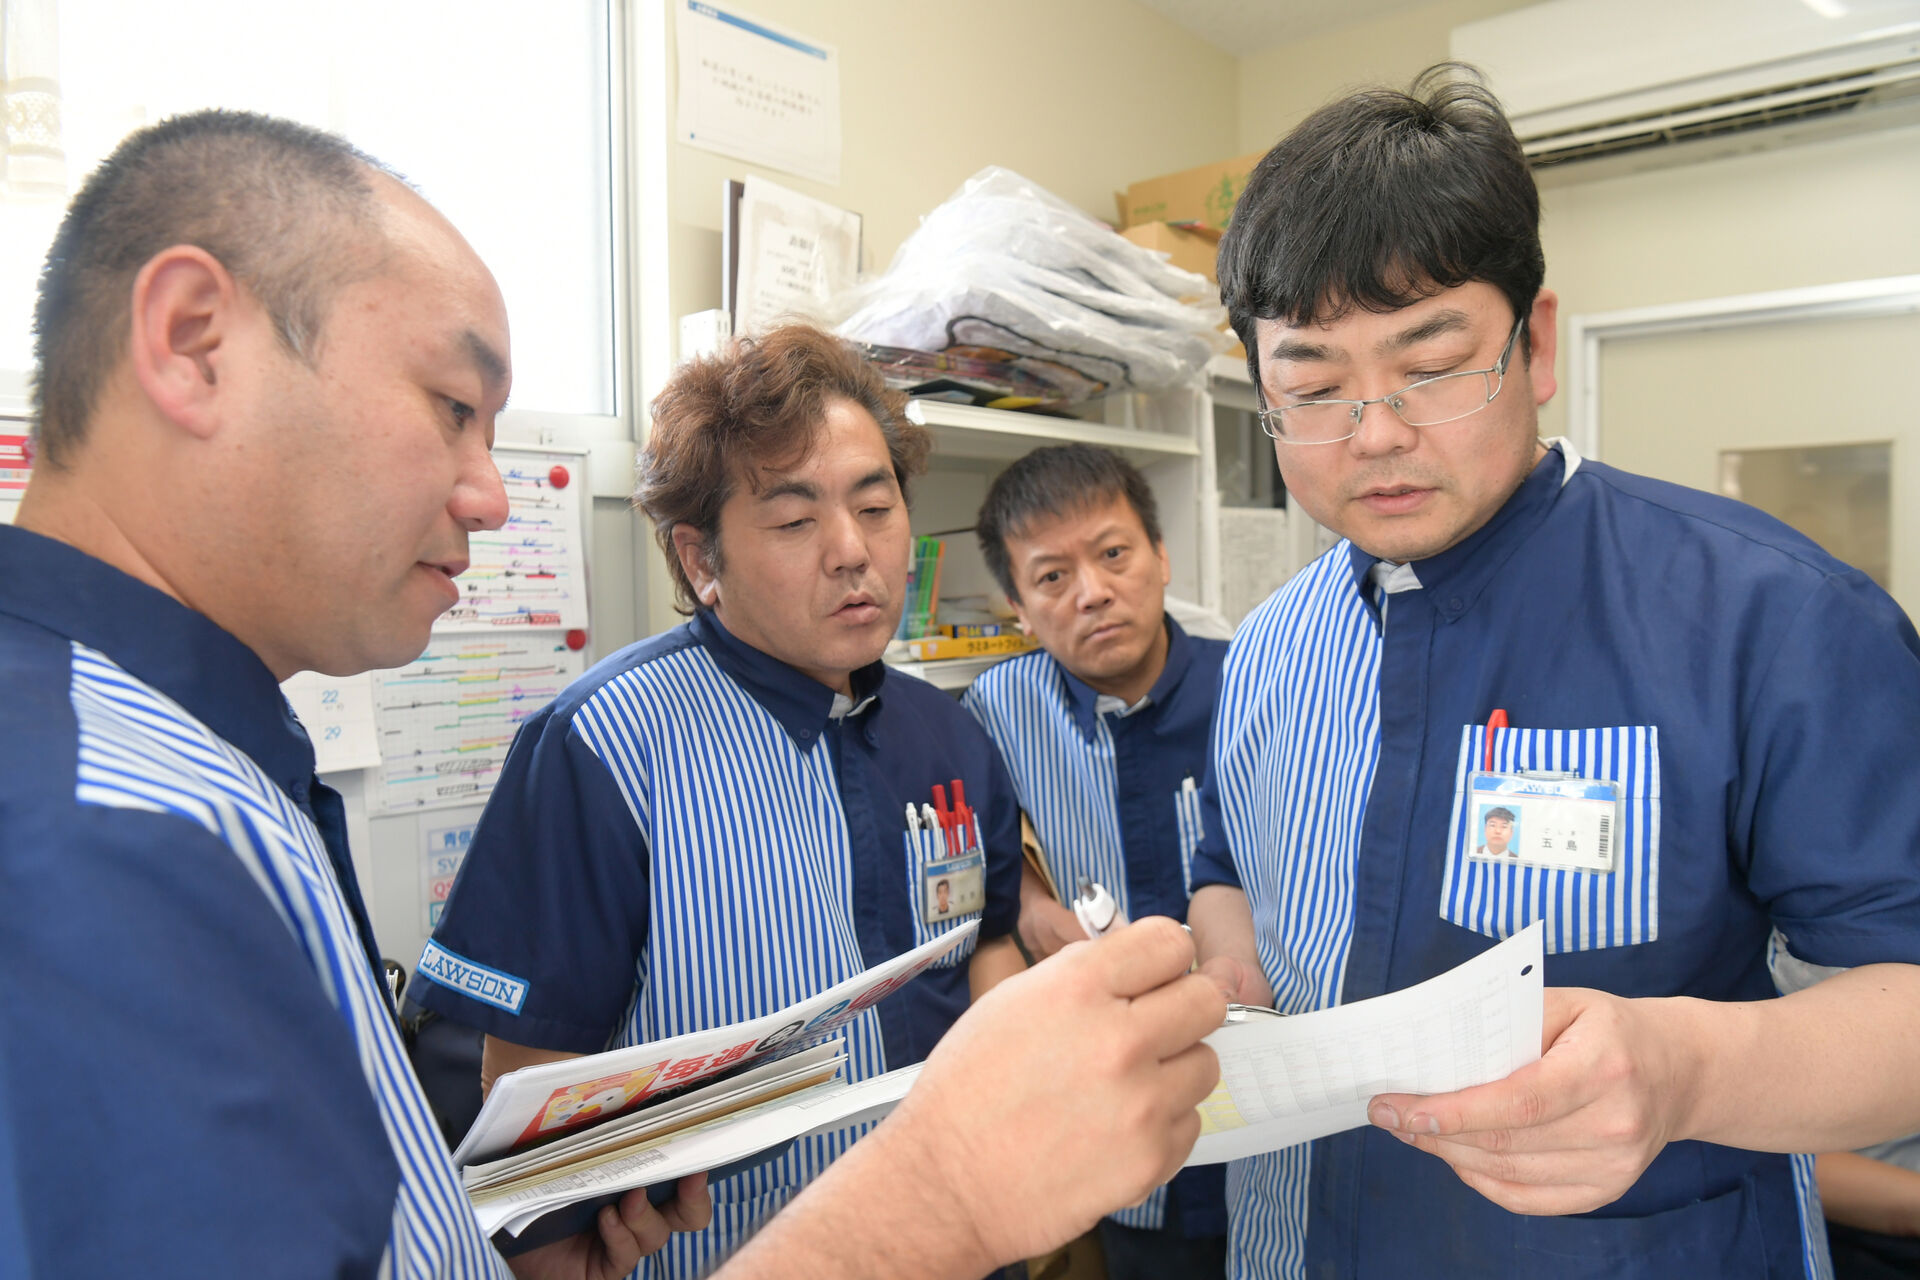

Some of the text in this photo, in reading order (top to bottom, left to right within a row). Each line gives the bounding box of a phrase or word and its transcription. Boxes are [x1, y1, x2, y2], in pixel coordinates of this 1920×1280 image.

[321, 689, 339, 704] 22
[324, 726, 342, 741] 29
[423, 949, 518, 1004] LAWSON
